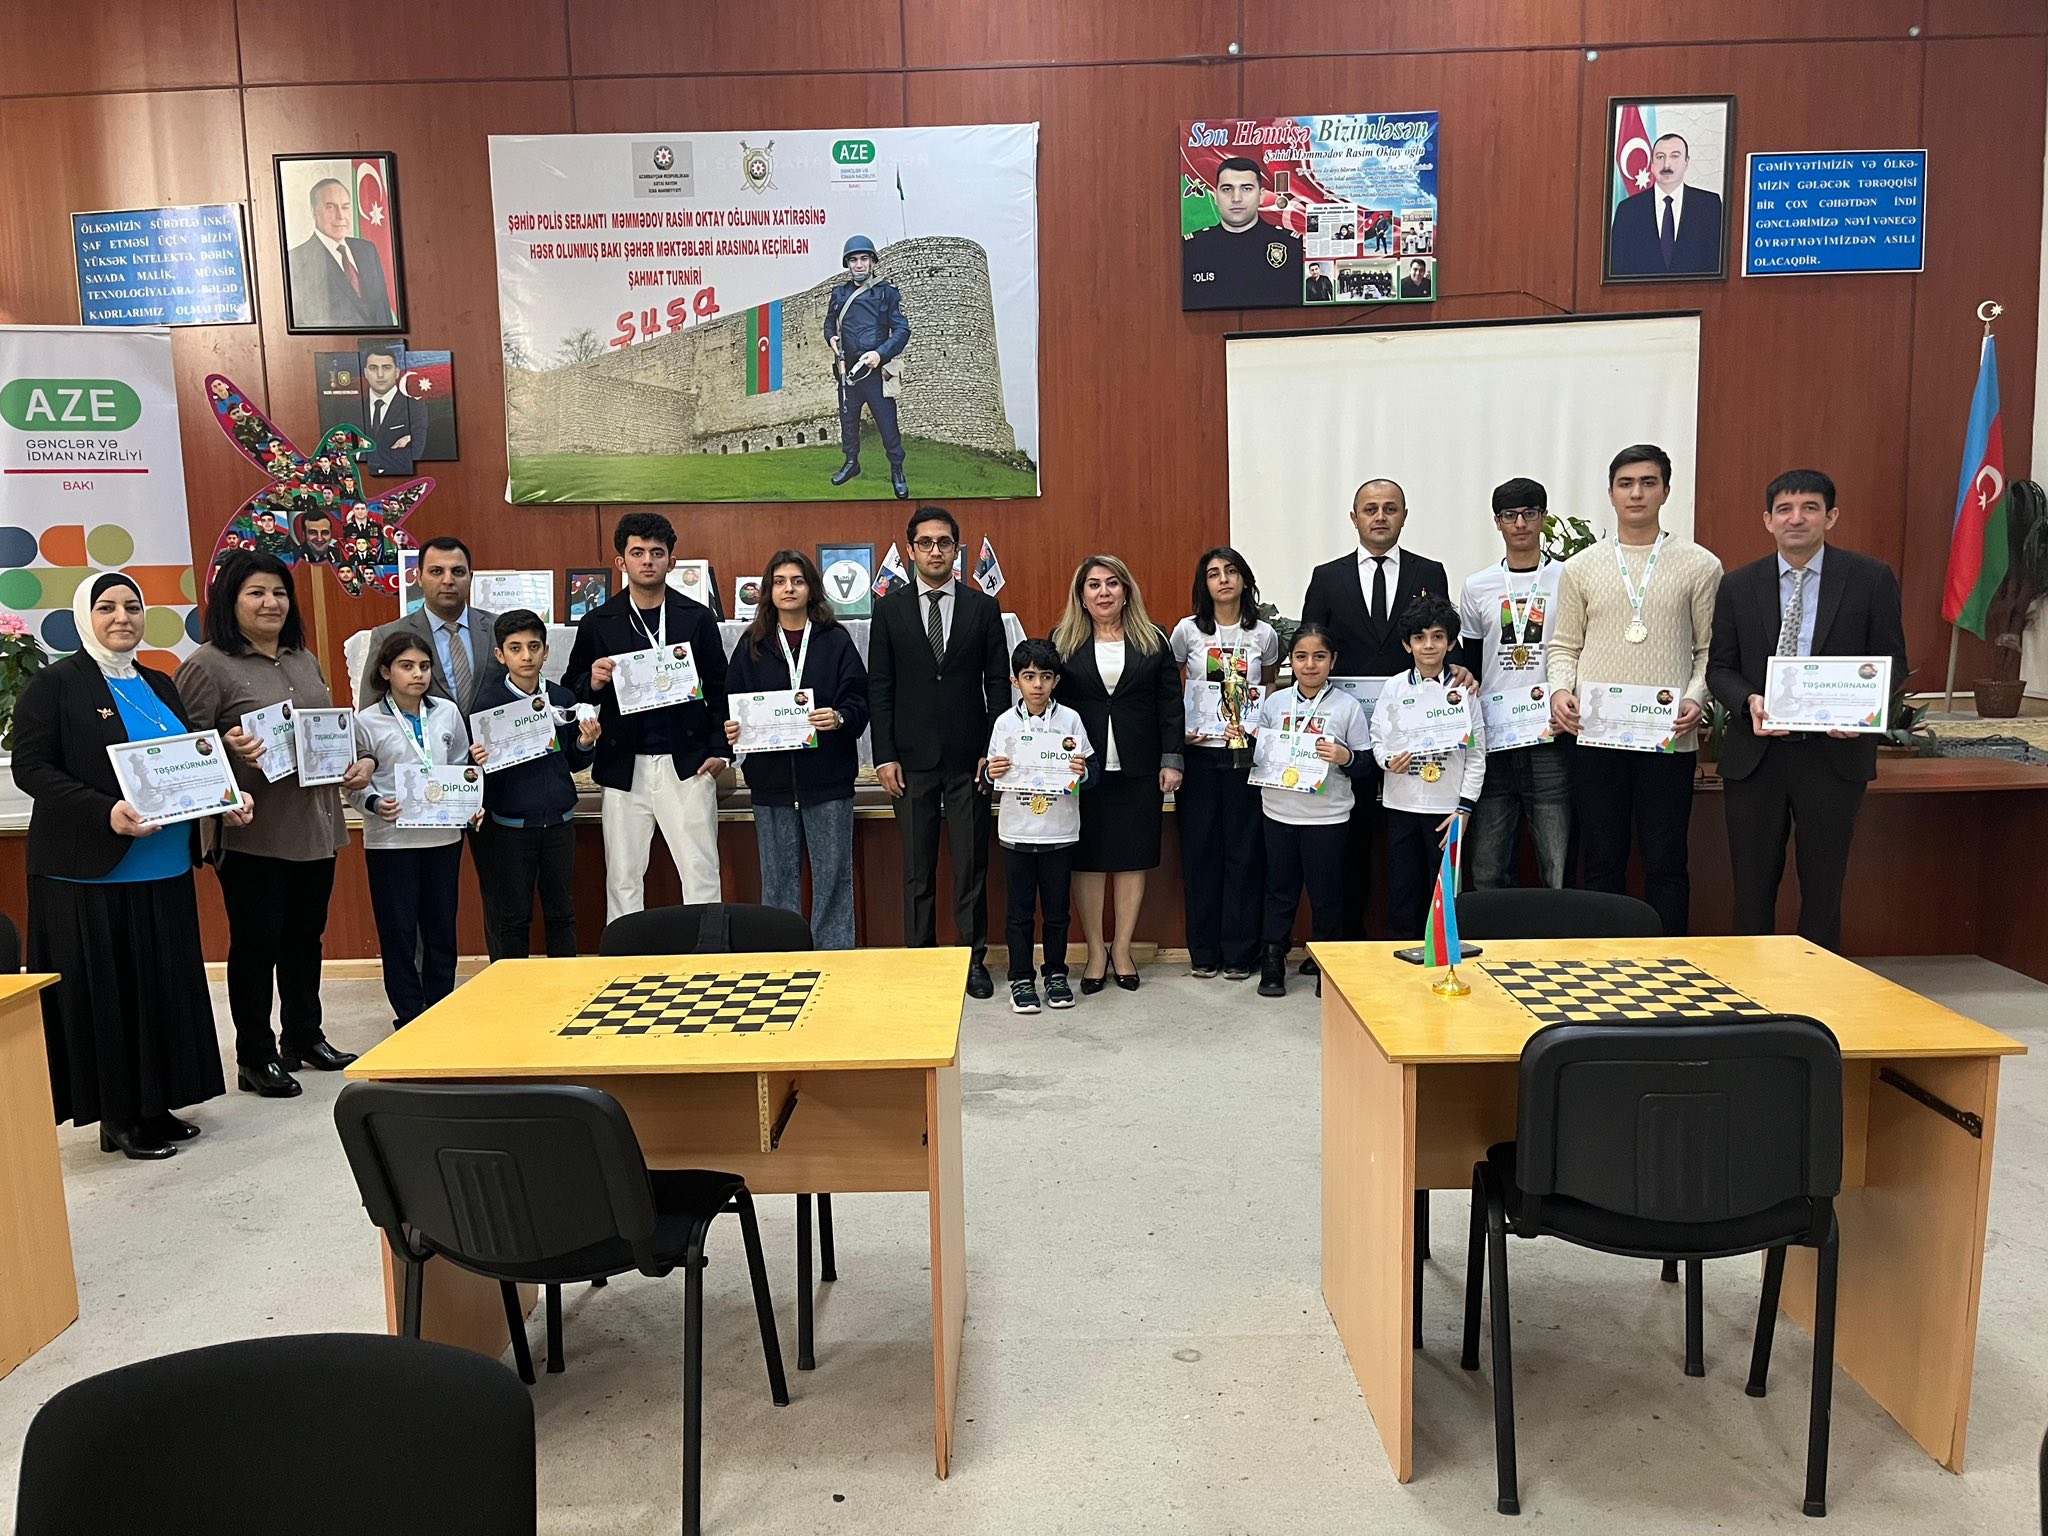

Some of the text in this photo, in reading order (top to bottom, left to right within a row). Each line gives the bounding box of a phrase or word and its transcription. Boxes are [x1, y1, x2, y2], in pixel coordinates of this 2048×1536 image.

[1189, 116, 1430, 150] Sən Həmişə Bizimləsən
[839, 144, 869, 160] AZE
[1263, 144, 1425, 163] Şəhid Məmmədov Rasim Oktay oğlu
[1757, 156, 1918, 172] CƏMİYYƏTİMİZİN VƏ ÖLKƏ-
[1757, 177, 1917, 190] MİZİN GƏLƏCƏK TƏRƏQQİSİ
[1756, 195, 1916, 211] BİR ÇOX CƏHƏTDƏN İNDİ
[81, 215, 231, 235] ÖLKƏMİZİN SÜRƏTLƏ İNKİ-
[508, 205, 826, 234] ŞƏHİD POLİS SERJANTI MƏMMƏDOV RASİM OKTAY OĞLUNUN XATİRƏSİNƏ
[1755, 216, 1839, 229] GƏNCLƏRİMİZƏ
[1844, 215, 1870, 226] NƏYİ
[82, 232, 232, 252] ŞAF ETMƏSİ ÜÇÜN BİZİM
[1754, 234, 1916, 248] ÖYRƏTMƏYİMİZDƏN ASILI
[530, 235, 810, 262] HƏSR OLUNMUŞ BAKI ŞƏHƏR MƏKTƏBLƏRİ ARASINDA KEÇİRİLƏN
[84, 250, 234, 268] YÜKSƏK İNTELEKTƏ, DƏRİN
[1754, 255, 1821, 267] OLACAQDİR.
[85, 273, 126, 284] SAVADA
[195, 266, 236, 278] MÜASİR
[628, 266, 702, 290] ŞAHMAT TURNİRİ
[202, 283, 238, 294] BƏLƏD
[89, 307, 164, 320] KADRLARIMIZ
[25, 388, 117, 422] AZE
[26, 439, 118, 450] GƏNCLƏR VƏ
[27, 448, 143, 461] İDMAN NAZİRLİYİ
[63, 480, 94, 491] BAKI
[1802, 680, 1876, 690] TƏŞƏKKÜRNAMƏ
[774, 706, 810, 718] DİPLOM
[1426, 706, 1465, 719] DİPLOM
[1512, 701, 1545, 715] DİPLOM
[1630, 703, 1673, 716] DİPLOM
[515, 711, 549, 728] DİPLOM
[1296, 749, 1322, 760] DİPLO
[153, 757, 219, 776] TƏŞƏKKÜRNAMƏ
[442, 782, 479, 792] DİPLOM
